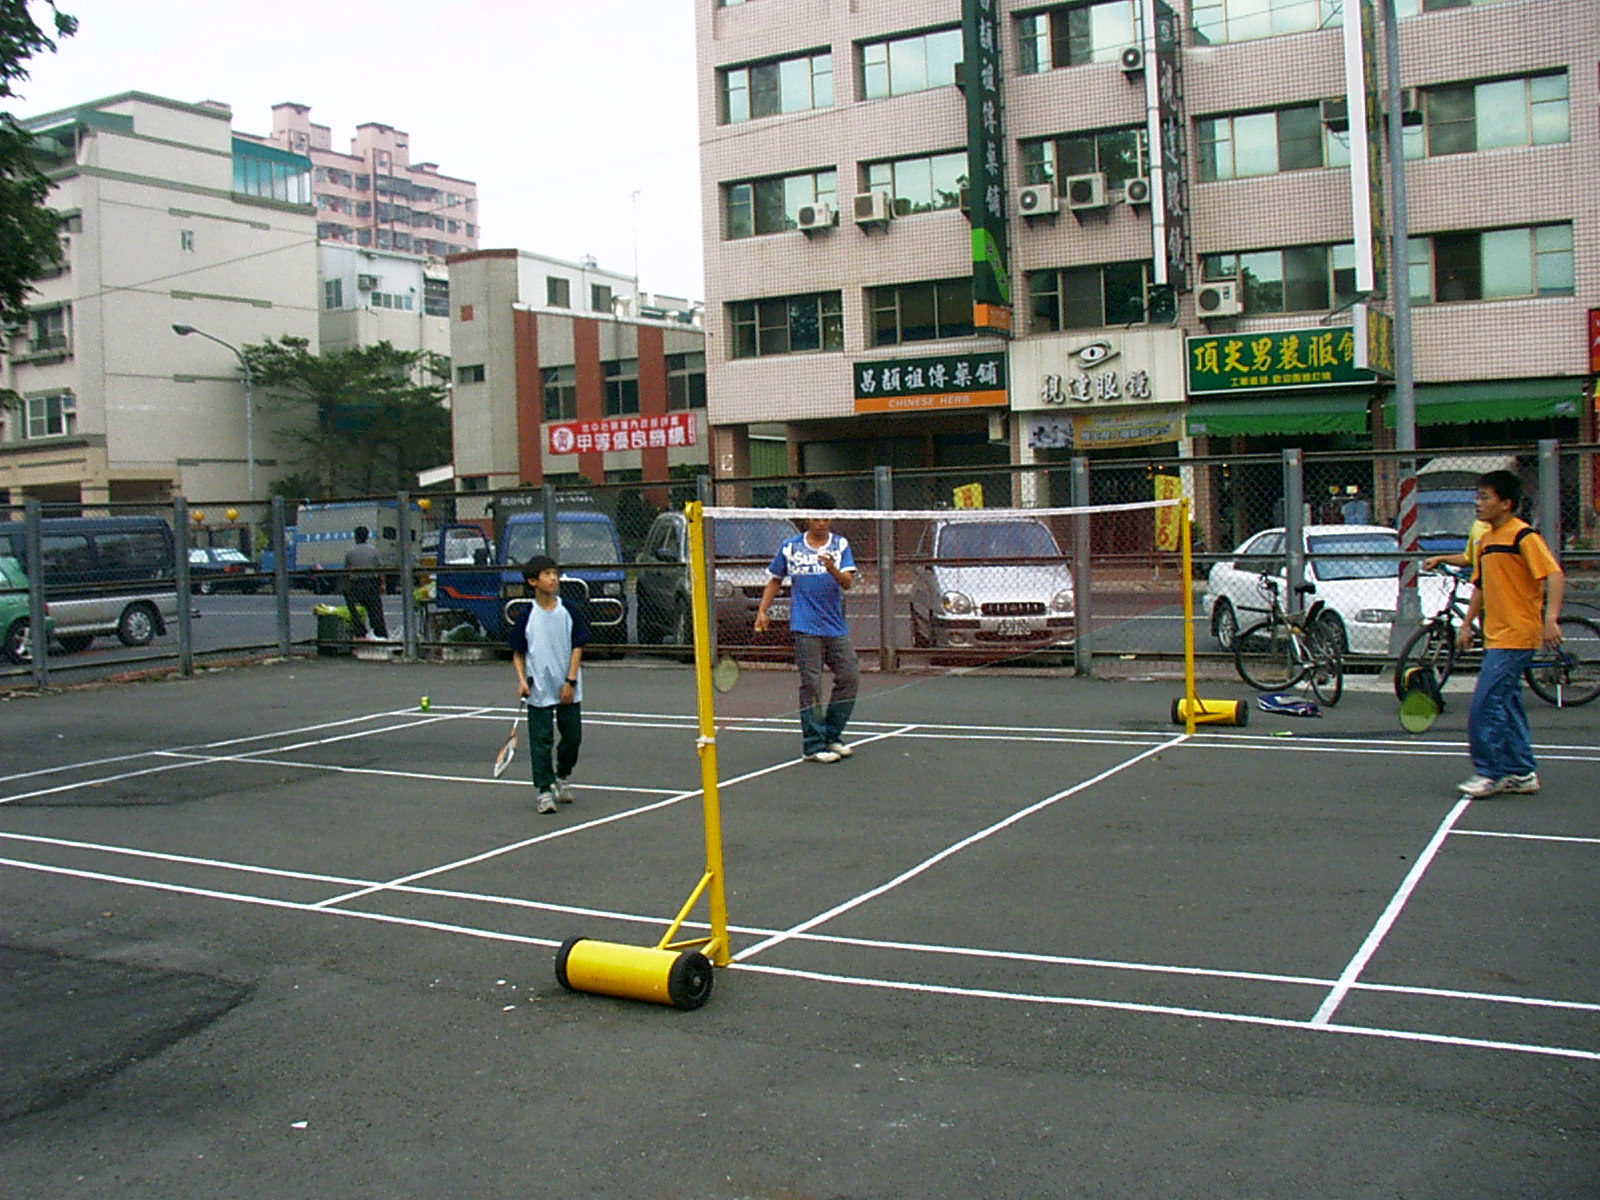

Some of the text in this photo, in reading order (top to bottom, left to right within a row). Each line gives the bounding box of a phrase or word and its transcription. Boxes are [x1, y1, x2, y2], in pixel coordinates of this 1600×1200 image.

[1042, 370, 1151, 404] 視達眼鏡
[889, 395, 970, 409] CHINESE HERB
